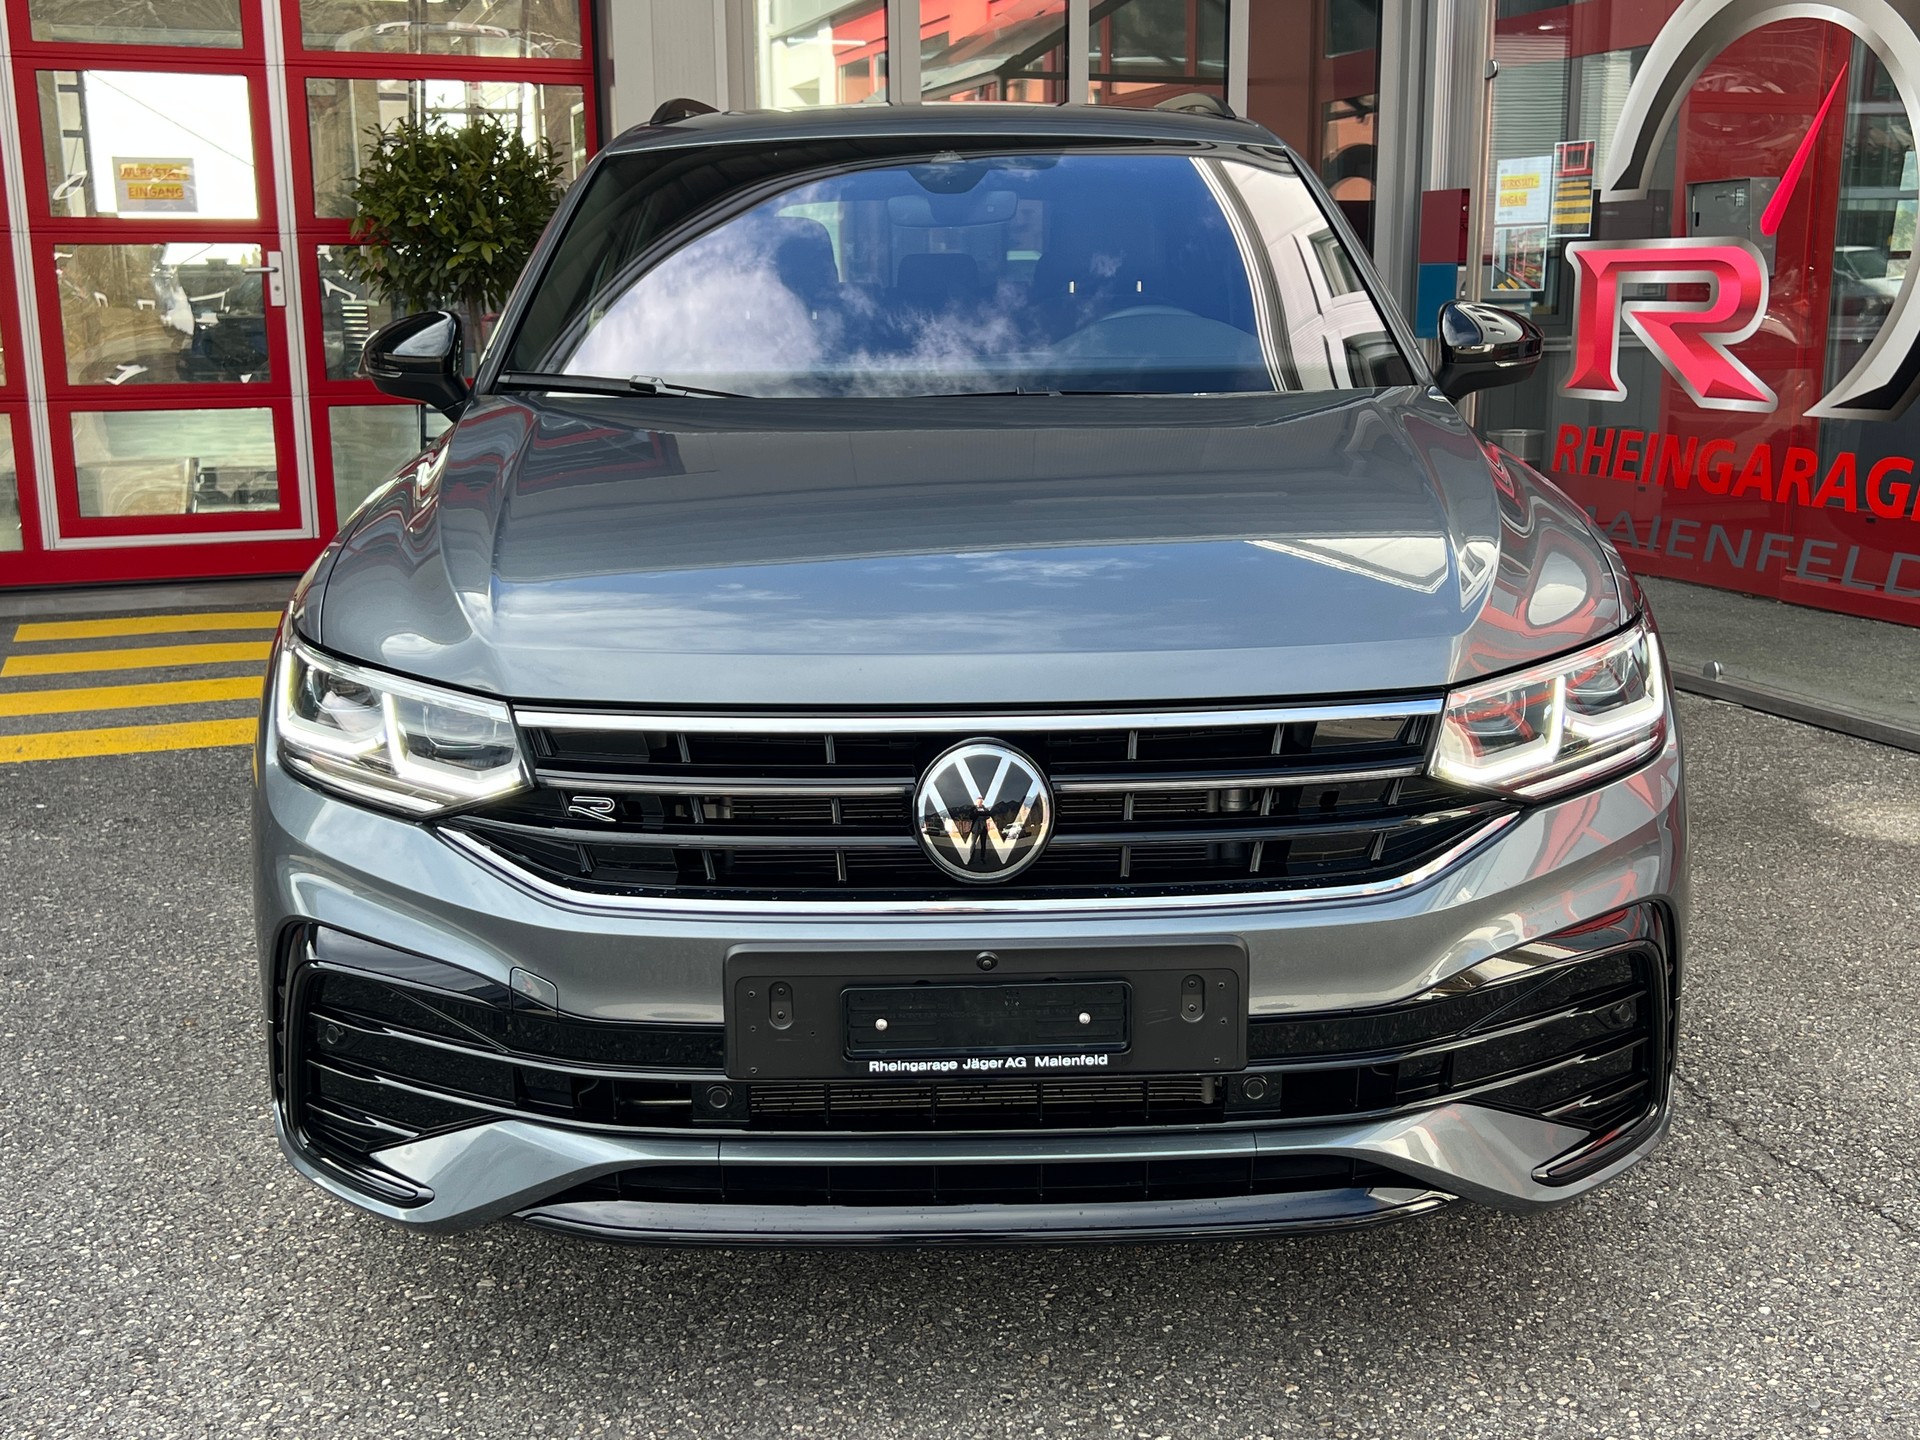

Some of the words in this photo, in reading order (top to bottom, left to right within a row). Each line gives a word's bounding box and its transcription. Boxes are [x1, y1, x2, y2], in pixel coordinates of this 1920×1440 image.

[128, 186, 184, 199] EINGANG
[1557, 236, 1778, 413] R
[1552, 423, 1920, 521] RHEINGARAG
[1584, 505, 1920, 597] AIENFELD
[869, 1060, 958, 1072] Rheingarage
[962, 1058, 1003, 1070] Jäger
[1004, 1056, 1027, 1068] AG
[1034, 1054, 1108, 1067] Maienfeld
